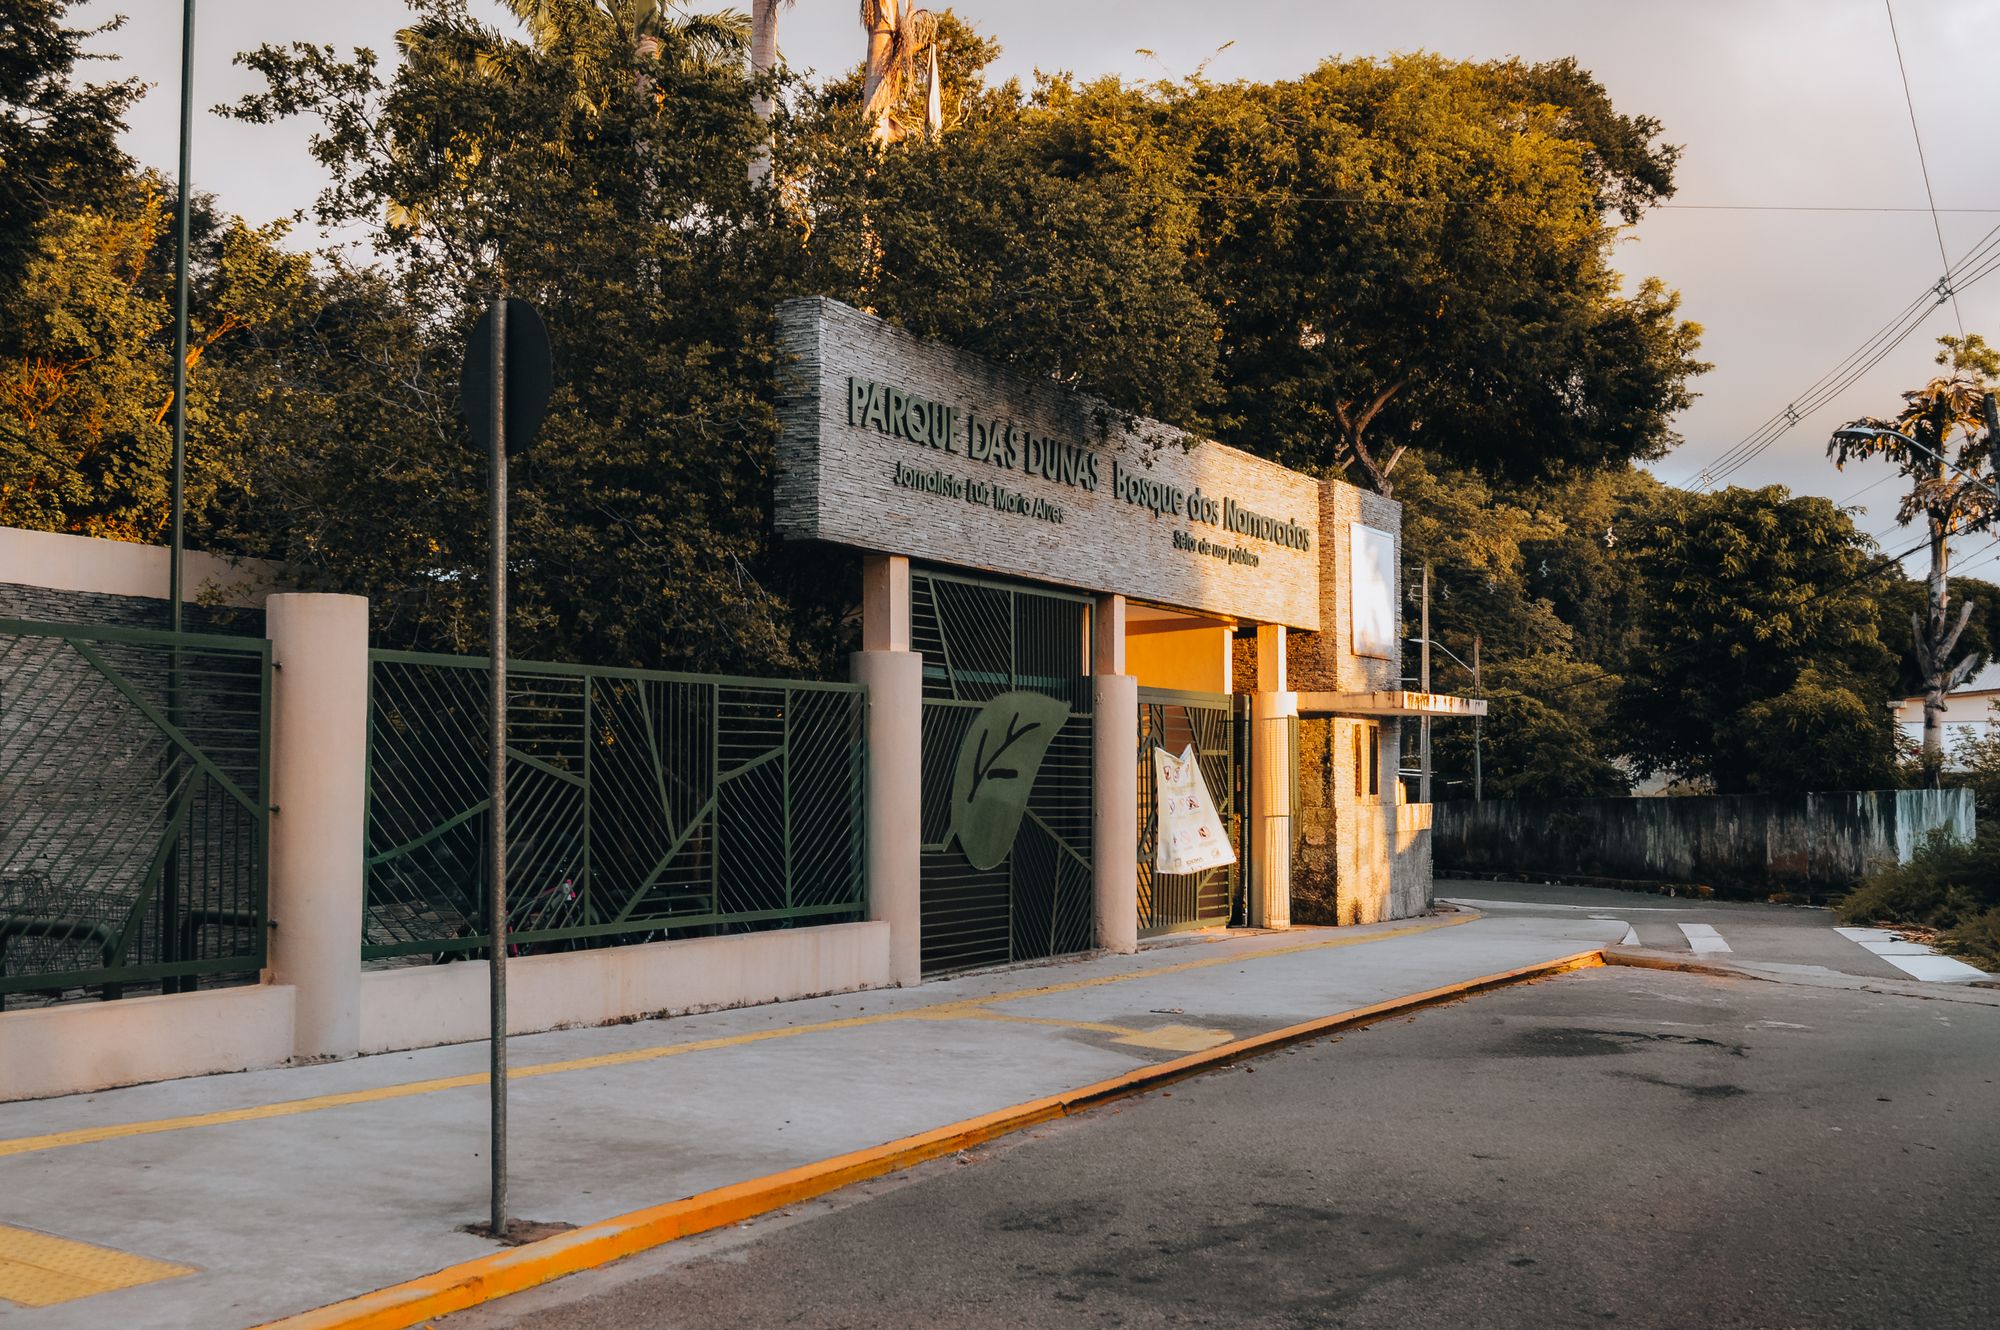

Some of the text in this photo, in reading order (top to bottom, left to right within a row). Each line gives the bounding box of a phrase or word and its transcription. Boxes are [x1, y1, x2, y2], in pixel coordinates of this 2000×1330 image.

[849, 376, 1100, 492] PARQUE DAS DUNAS
[893, 461, 963, 500] Jornalista
[966, 479, 990, 505] Luiz
[1031, 498, 1064, 523] Alves
[1113, 460, 1309, 552] Bosque dos Namorados
[1173, 529, 1259, 567] Setor de uso público
